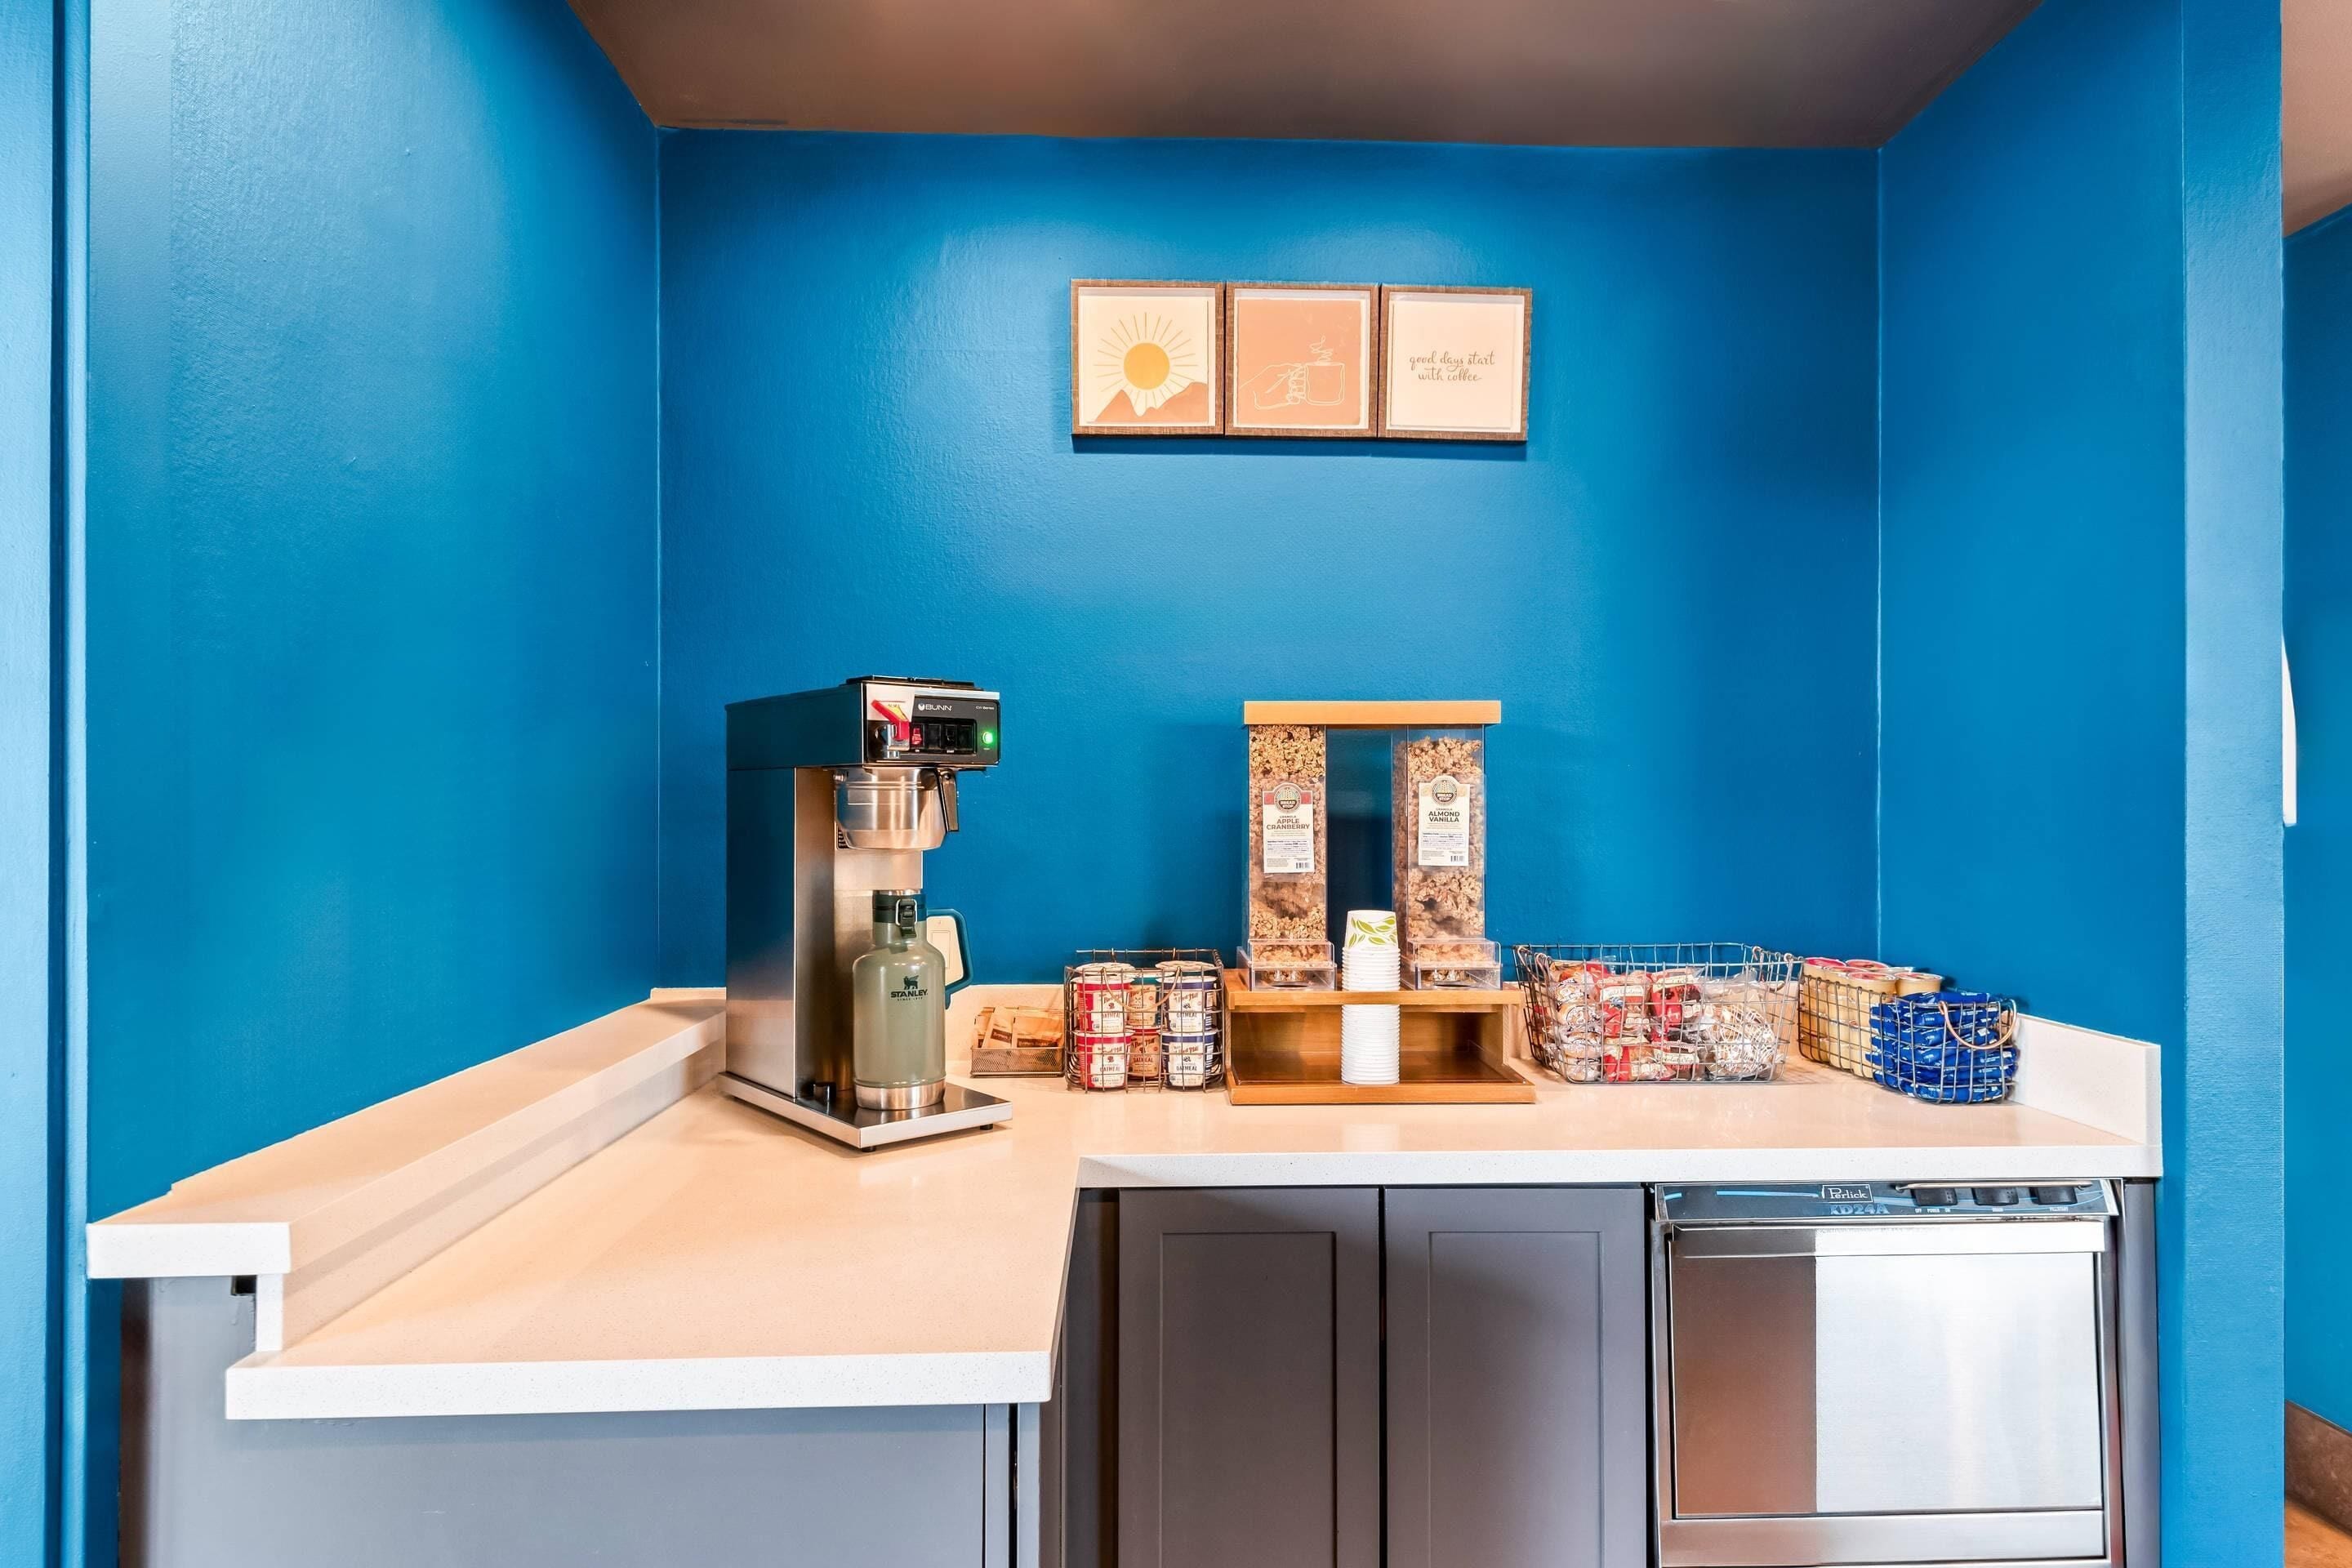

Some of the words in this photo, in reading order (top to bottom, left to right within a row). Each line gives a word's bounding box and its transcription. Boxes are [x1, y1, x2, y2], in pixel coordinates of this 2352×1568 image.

[1410, 350, 1437, 371] good
[1440, 351, 1463, 372] days
[1468, 351, 1495, 365] start
[1418, 367, 1443, 381] with
[1447, 368, 1482, 381] coffee
[925, 703, 952, 711] BUNN
[890, 989, 927, 998] STANLEY
[1828, 1187, 1868, 1199] Perlick
